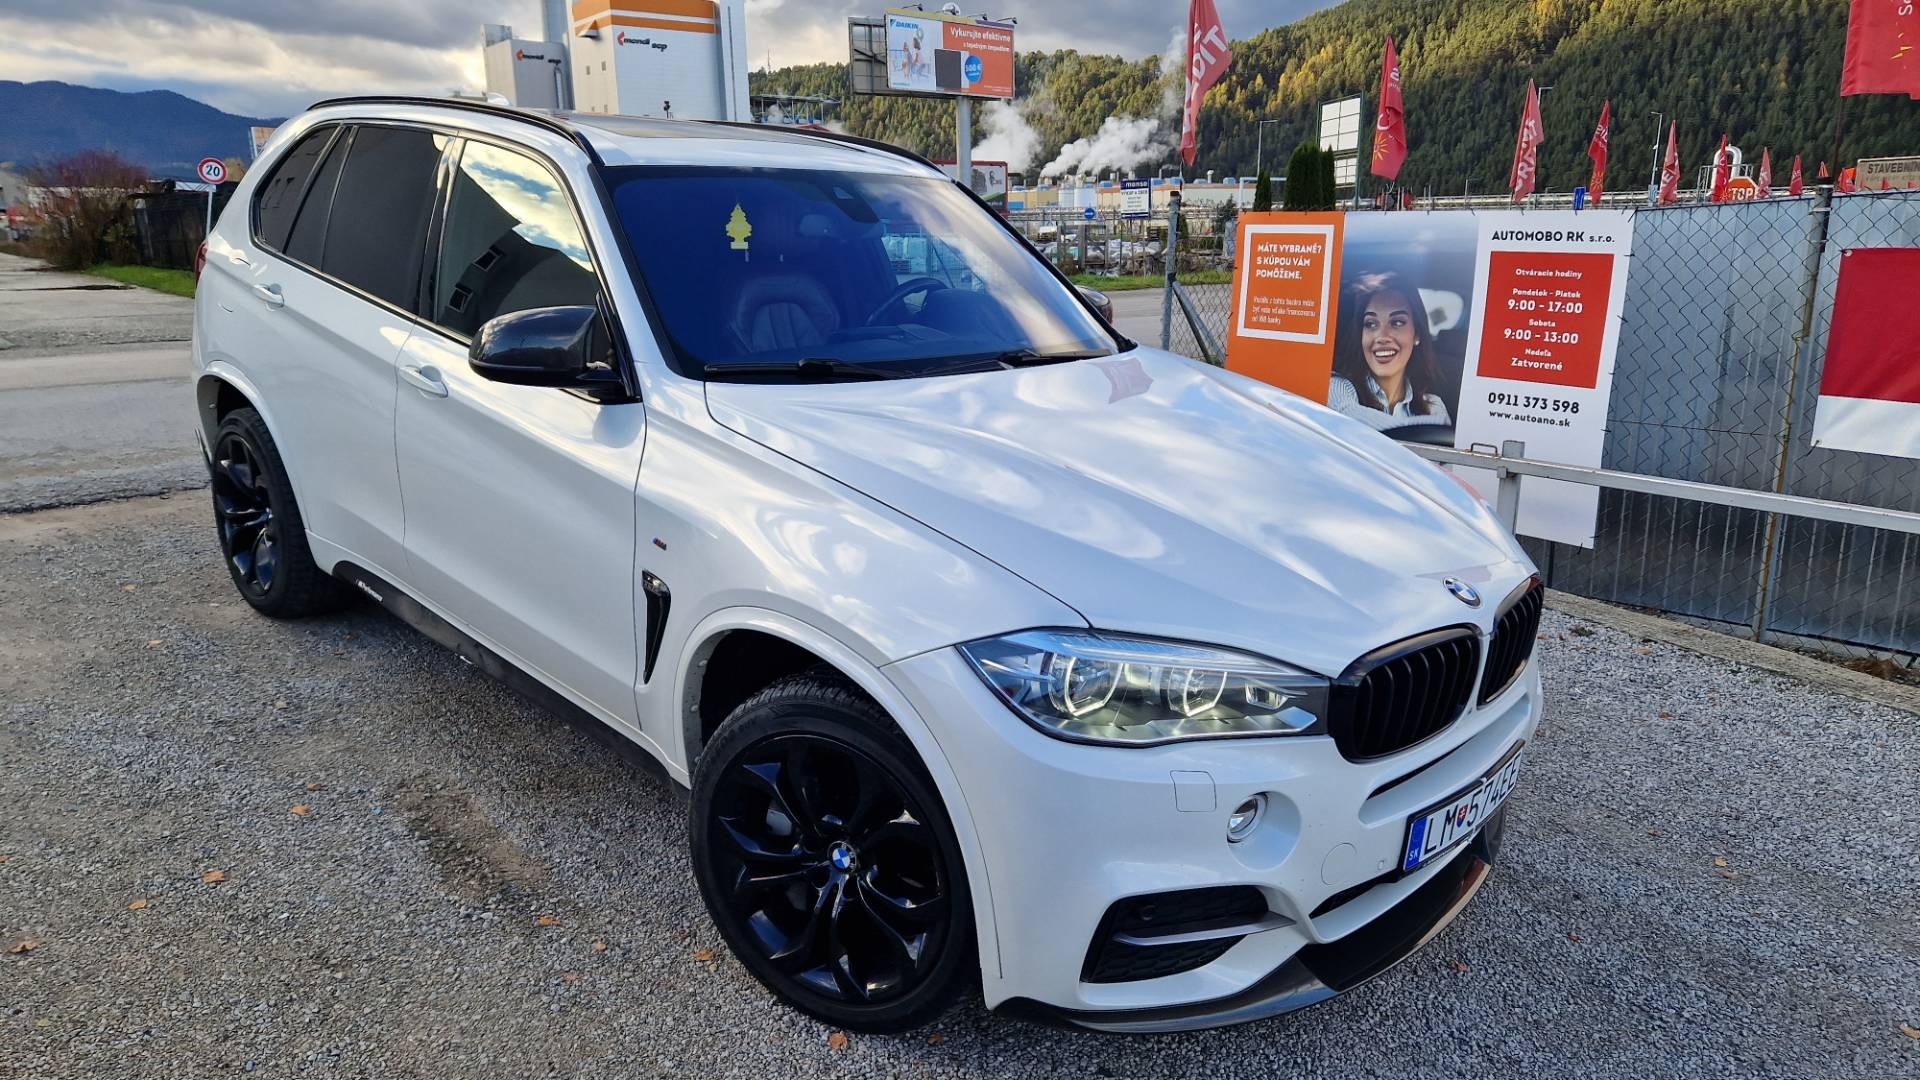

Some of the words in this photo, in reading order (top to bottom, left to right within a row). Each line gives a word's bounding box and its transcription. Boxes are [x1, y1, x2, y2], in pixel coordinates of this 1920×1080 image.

[896, 21, 918, 30] DAIKIN
[206, 164, 220, 177] 20
[1491, 230, 1562, 242] AUTOMOBO
[1566, 231, 1585, 242] RK
[1589, 234, 1615, 243] s.r.o.
[1257, 241, 1278, 253] MÁTE
[1279, 242, 1322, 254] VYBRANÉ?
[1256, 256, 1262, 265] S
[1263, 255, 1292, 266] KÚPOU
[1293, 255, 1310, 267] VÁM
[1256, 267, 1302, 280] POMÔŽEME.
[1515, 268, 1553, 278] Otváracie
[1555, 269, 1582, 279] hodiny
[1512, 288, 1548, 297] Pondelok
[1555, 290, 1581, 299] Piatok
[1507, 299, 1536, 311] 9:00
[1547, 301, 1583, 314] 17:00
[1528, 318, 1556, 327] Sobota
[1503, 328, 1531, 340] 9:00
[1544, 331, 1579, 344] 13:00
[1525, 348, 1552, 357] Nedeľa
[1511, 357, 1563, 371] Zatvorené
[1488, 392, 1519, 407] 0911
[1523, 396, 1548, 410] 373
[1552, 400, 1580, 414] 598
[1489, 410, 1570, 427] www.autoano.sk
[1423, 803, 1459, 856] LM
[1466, 752, 1522, 828] 574EE
[1408, 848, 1419, 861] SK
